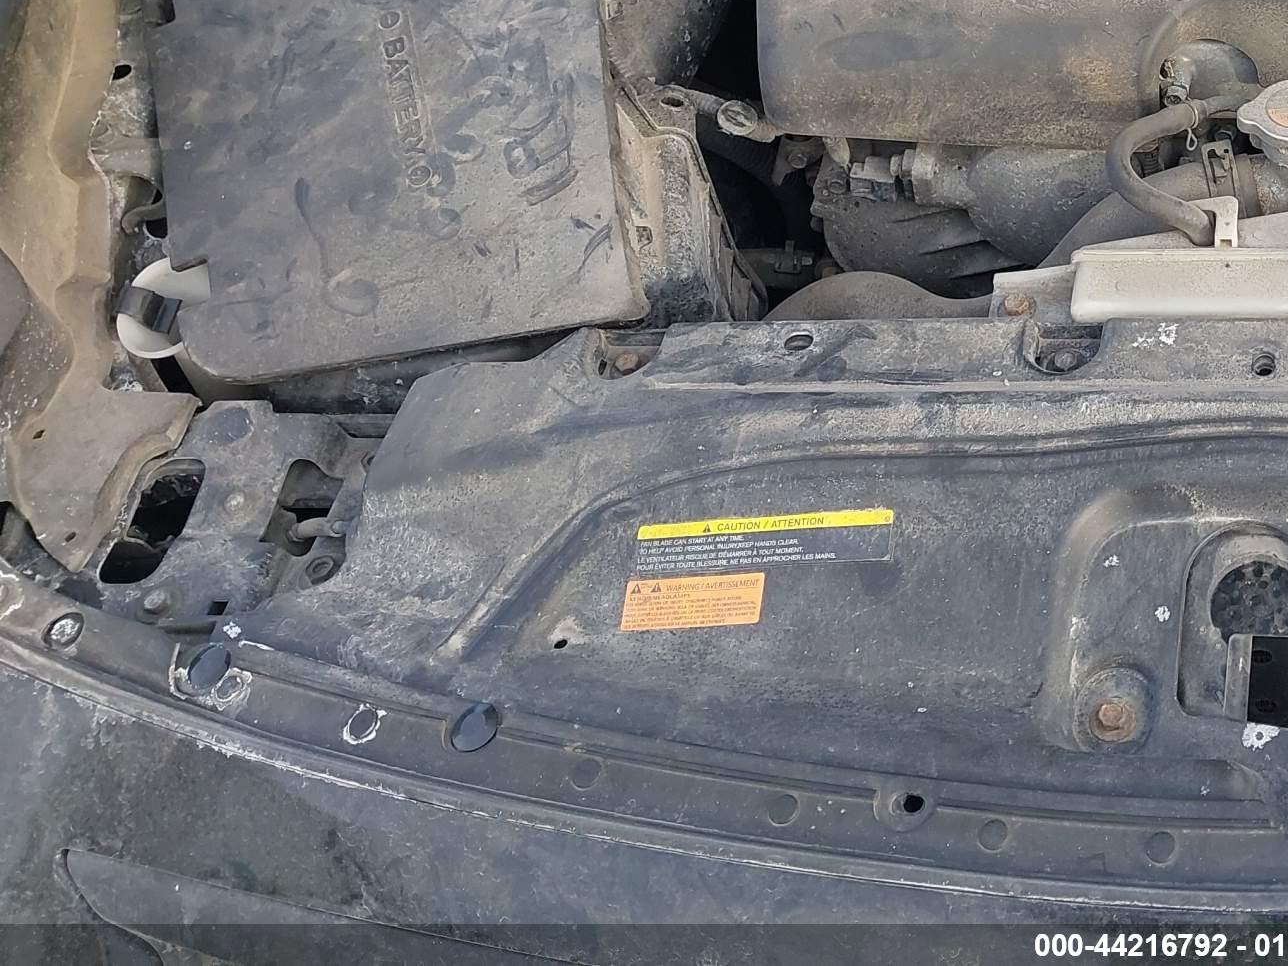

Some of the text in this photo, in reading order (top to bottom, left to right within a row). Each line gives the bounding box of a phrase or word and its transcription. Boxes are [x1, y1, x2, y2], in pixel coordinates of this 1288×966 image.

[381, 36, 427, 159] BATTERY
[717, 521, 761, 532] CAUTION
[771, 517, 824, 529] ATTENTION
[684, 544, 715, 552] PERSONAL
[645, 554, 683, 563] VENTILATEUR
[685, 553, 708, 561] RISQUE
[718, 549, 752, 558] DÉMARRER
[654, 562, 675, 570] ÉVITER
[676, 561, 696, 569] TOUTE
[762, 554, 801, 563] APPROCHER
[666, 583, 700, 592] WARNING
[705, 579, 760, 589] AVERTISSEMENT
